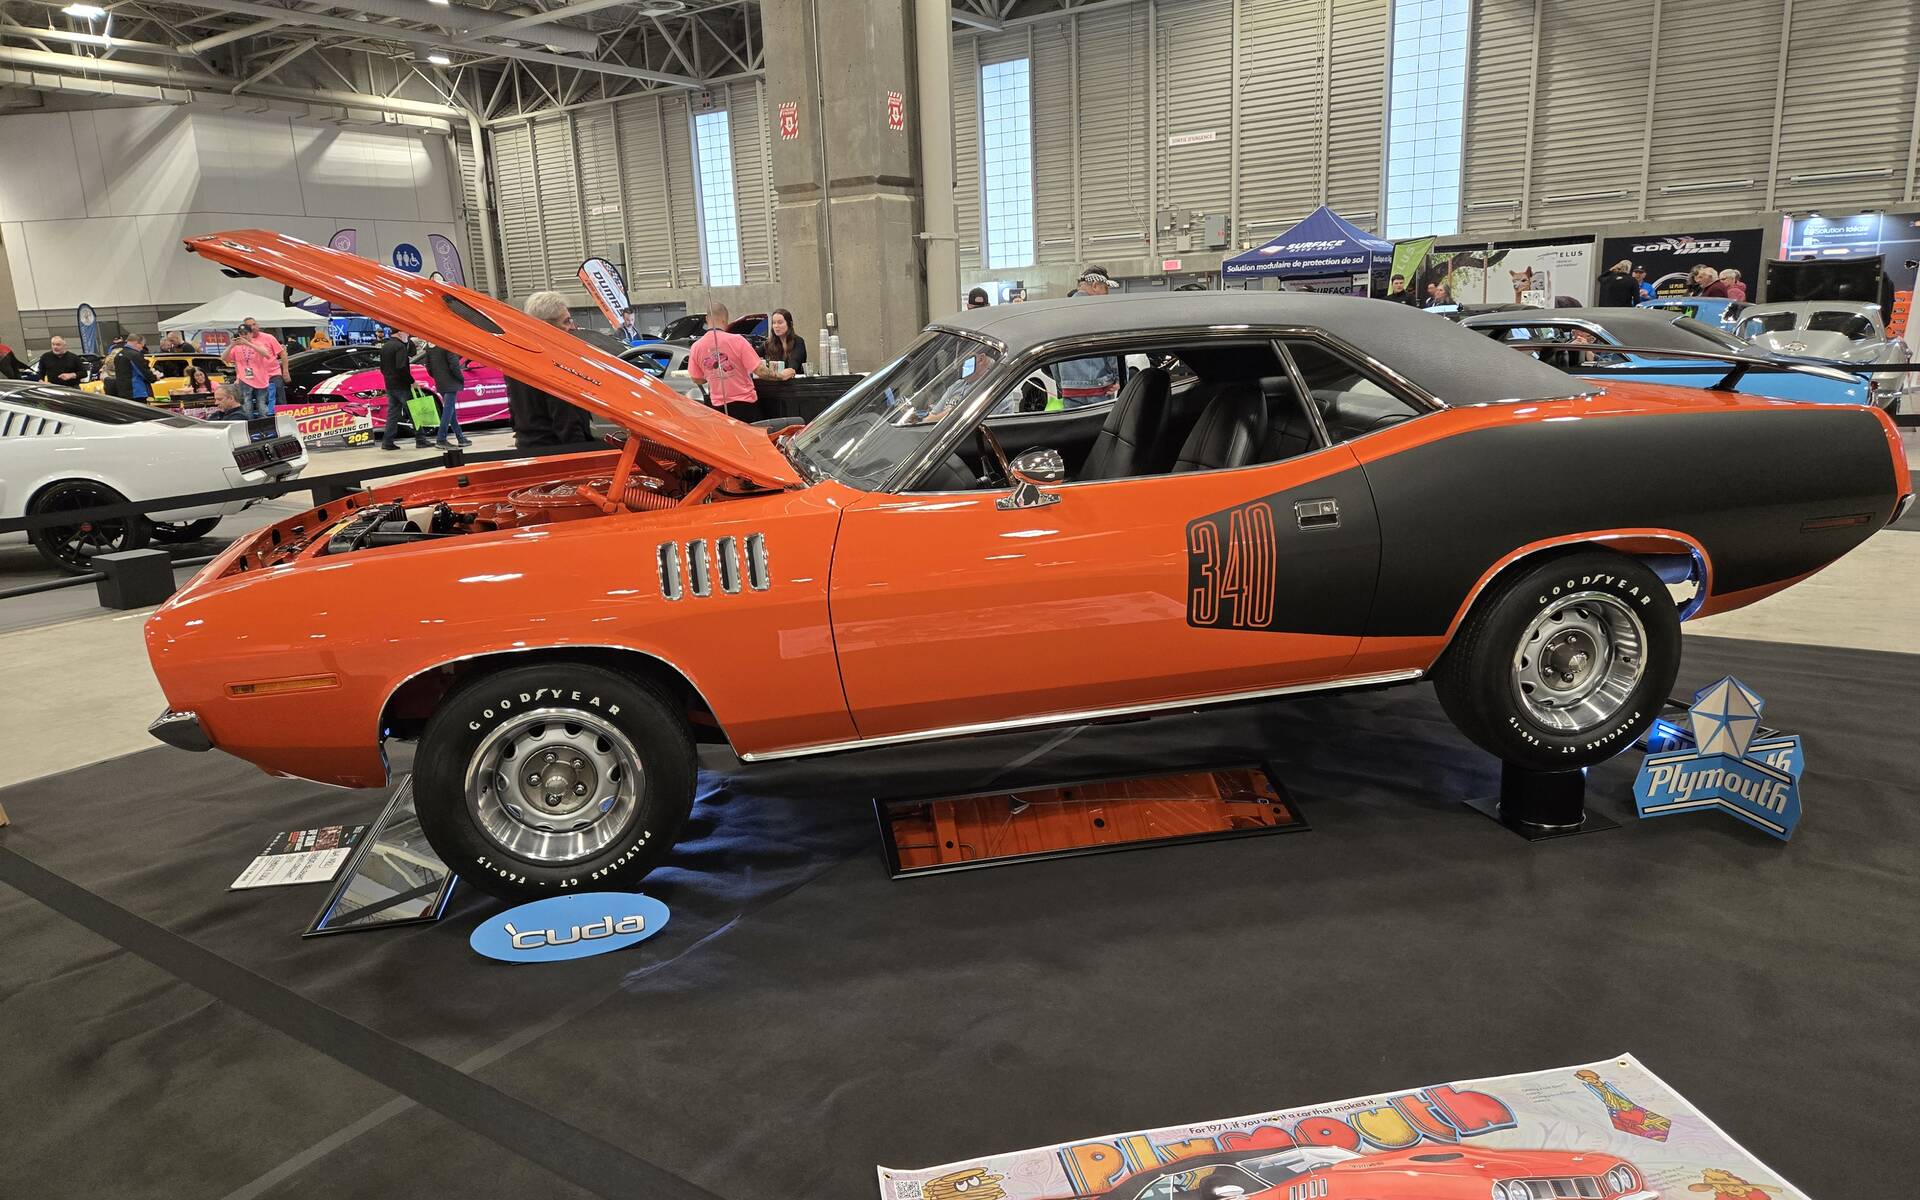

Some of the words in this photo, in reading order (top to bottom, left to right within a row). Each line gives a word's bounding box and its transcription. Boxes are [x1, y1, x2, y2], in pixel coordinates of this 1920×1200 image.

[1286, 239, 1346, 250] SURFACE
[1632, 240, 1732, 253] CORVETTE
[1227, 264, 1255, 273] Solution
[1256, 260, 1291, 271] modulaire
[1293, 259, 1302, 267] de
[1303, 257, 1341, 269] protection
[1341, 257, 1351, 265] de
[1352, 256, 1364, 264] sol
[298, 414, 355, 434] AGNEZ
[324, 426, 357, 436] MUSTANG
[348, 432, 369, 444] 20$
[1191, 502, 1277, 627] 340
[1539, 574, 1651, 606] GOODYEAR
[468, 688, 620, 731] GOODYEAR
[1587, 711, 1641, 750] POLYGLAS
[1648, 763, 1791, 814] Plymouth
[592, 830, 652, 880] POLYGLAS
[476, 856, 526, 885] F60-15
[560, 878, 578, 888] GT
[1189, 1127, 1206, 1135] For
[1242, 1118, 1260, 1129] you
[1261, 1114, 1286, 1124] wnt
[1297, 1110, 1312, 1119] car
[1312, 1106, 1333, 1117] that
[1334, 1102, 1366, 1113] makes
[1057, 1083, 1518, 1196] Plymouth
